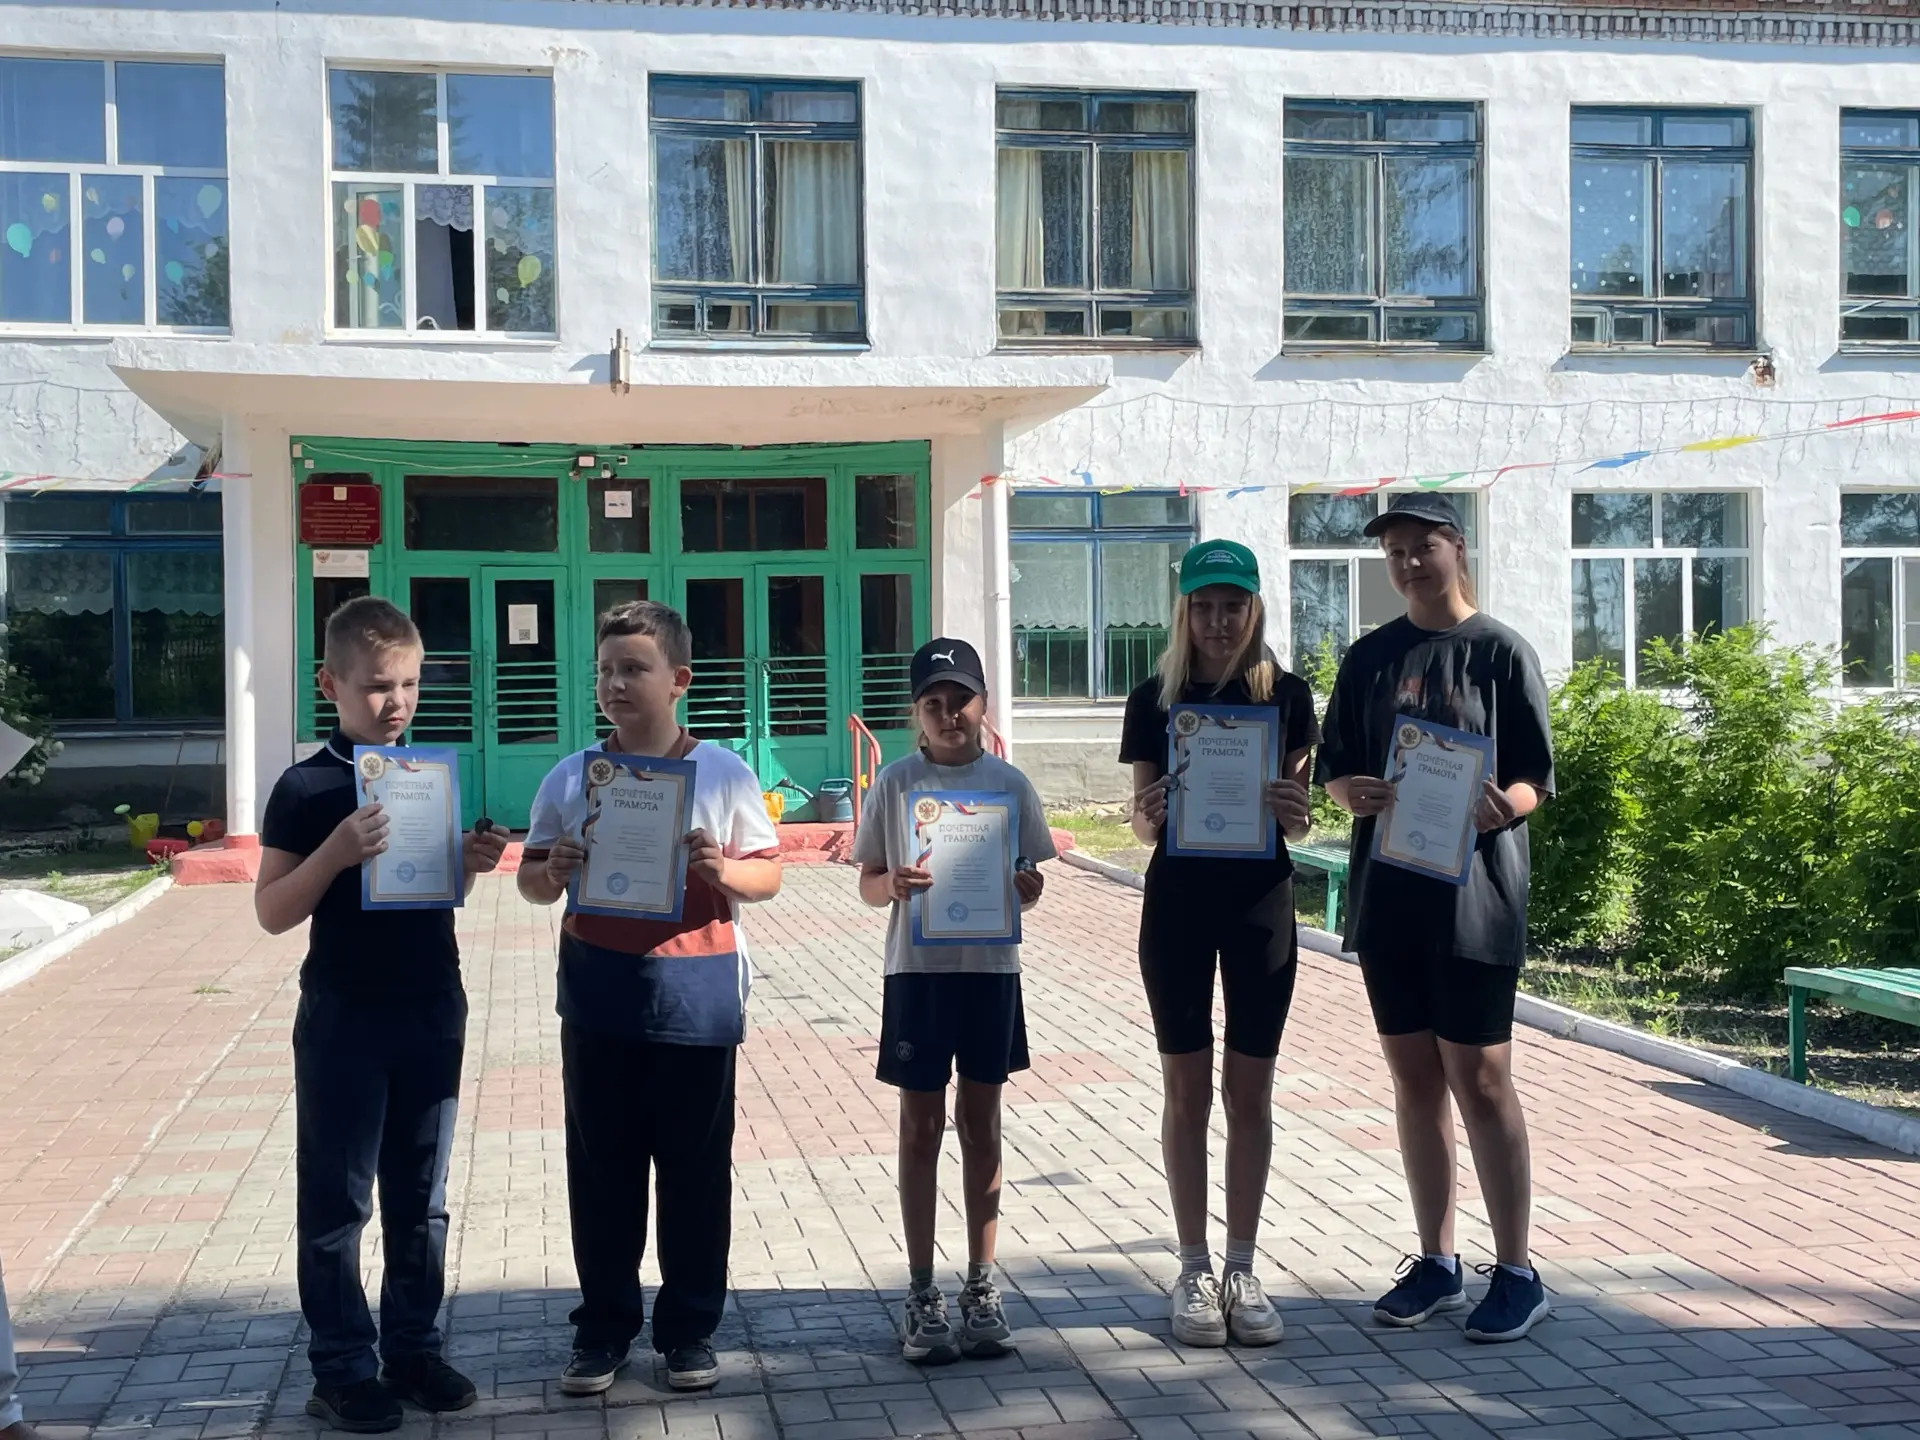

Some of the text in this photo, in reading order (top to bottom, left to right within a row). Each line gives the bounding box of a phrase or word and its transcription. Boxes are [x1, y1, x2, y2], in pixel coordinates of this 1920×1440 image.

[1202, 747, 1245, 757] ГРАМОТА
[1418, 763, 1457, 780] ГРАМОТА
[390, 791, 431, 801] ГРАМОТА
[614, 799, 659, 811] ГРАМОТА
[943, 833, 987, 843] ГРАМОТА
